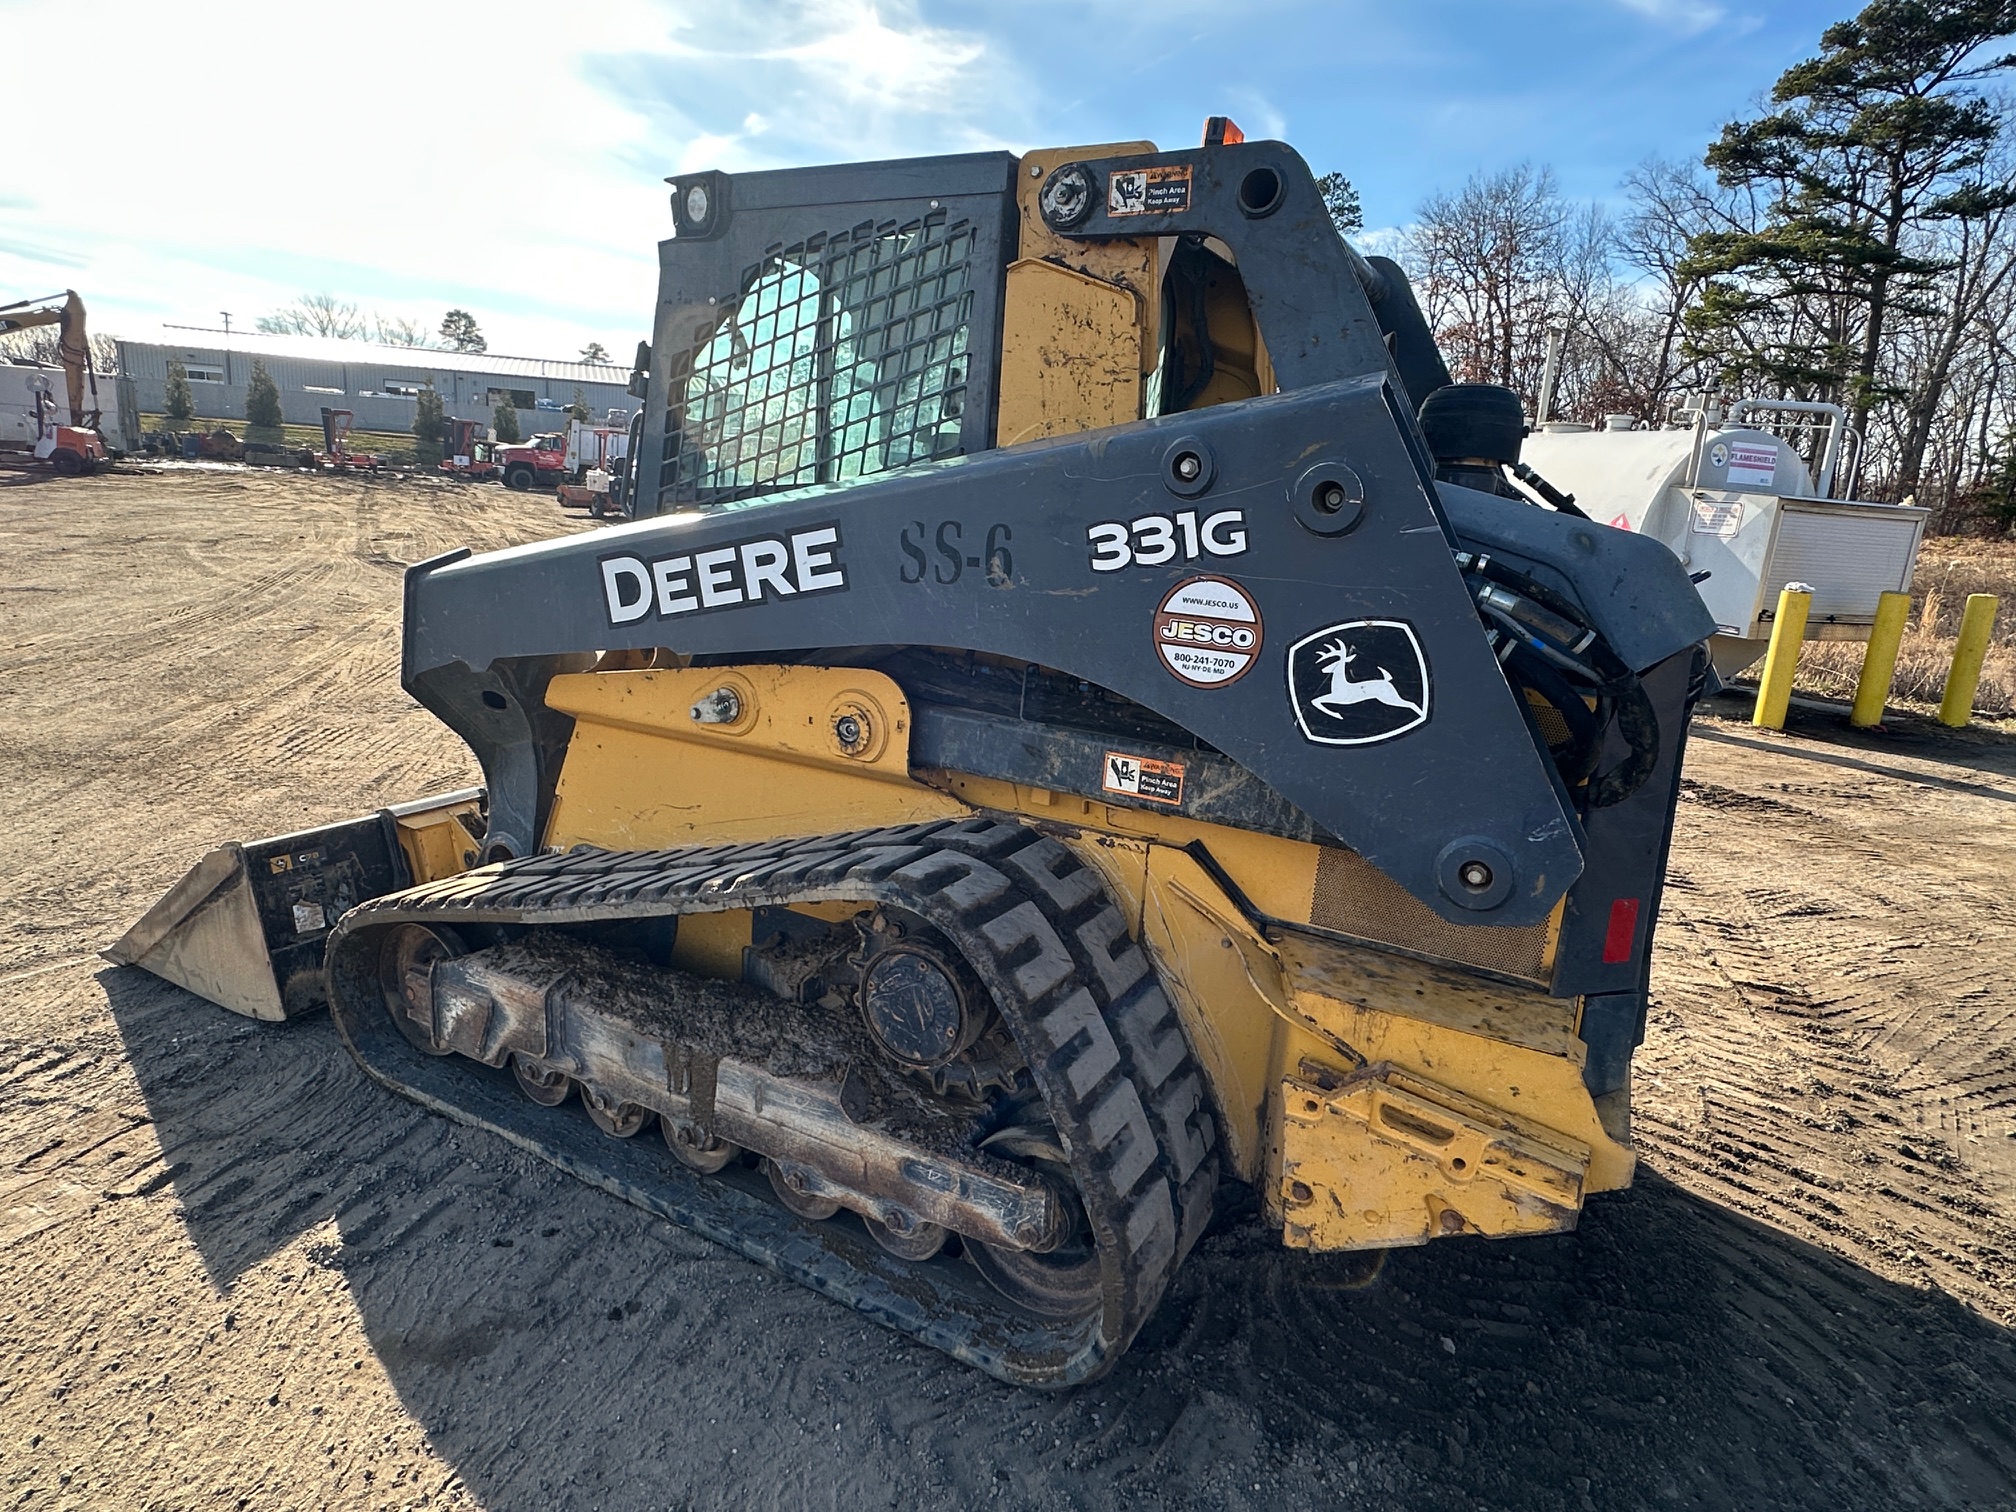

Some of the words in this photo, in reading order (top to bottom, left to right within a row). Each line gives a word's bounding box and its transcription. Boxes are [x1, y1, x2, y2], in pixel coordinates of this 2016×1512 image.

[1169, 186, 1186, 194] Area
[1147, 197, 1163, 205] Keep
[1164, 196, 1180, 204] Away
[1730, 453, 1776, 464] FLAMESHIELD
[1088, 510, 1248, 571] 331G
[900, 520, 1013, 587] SS-6
[601, 527, 844, 623] DEERE
[1182, 596, 1239, 610] WWW.JESCO.US
[1160, 619, 1256, 649] JESCO
[1174, 652, 1235, 669] 800-241-7070
[1141, 775, 1160, 784] Pinch
[1161, 779, 1178, 788] Area
[1140, 784, 1155, 792] Keep
[1156, 787, 1172, 796] Away
